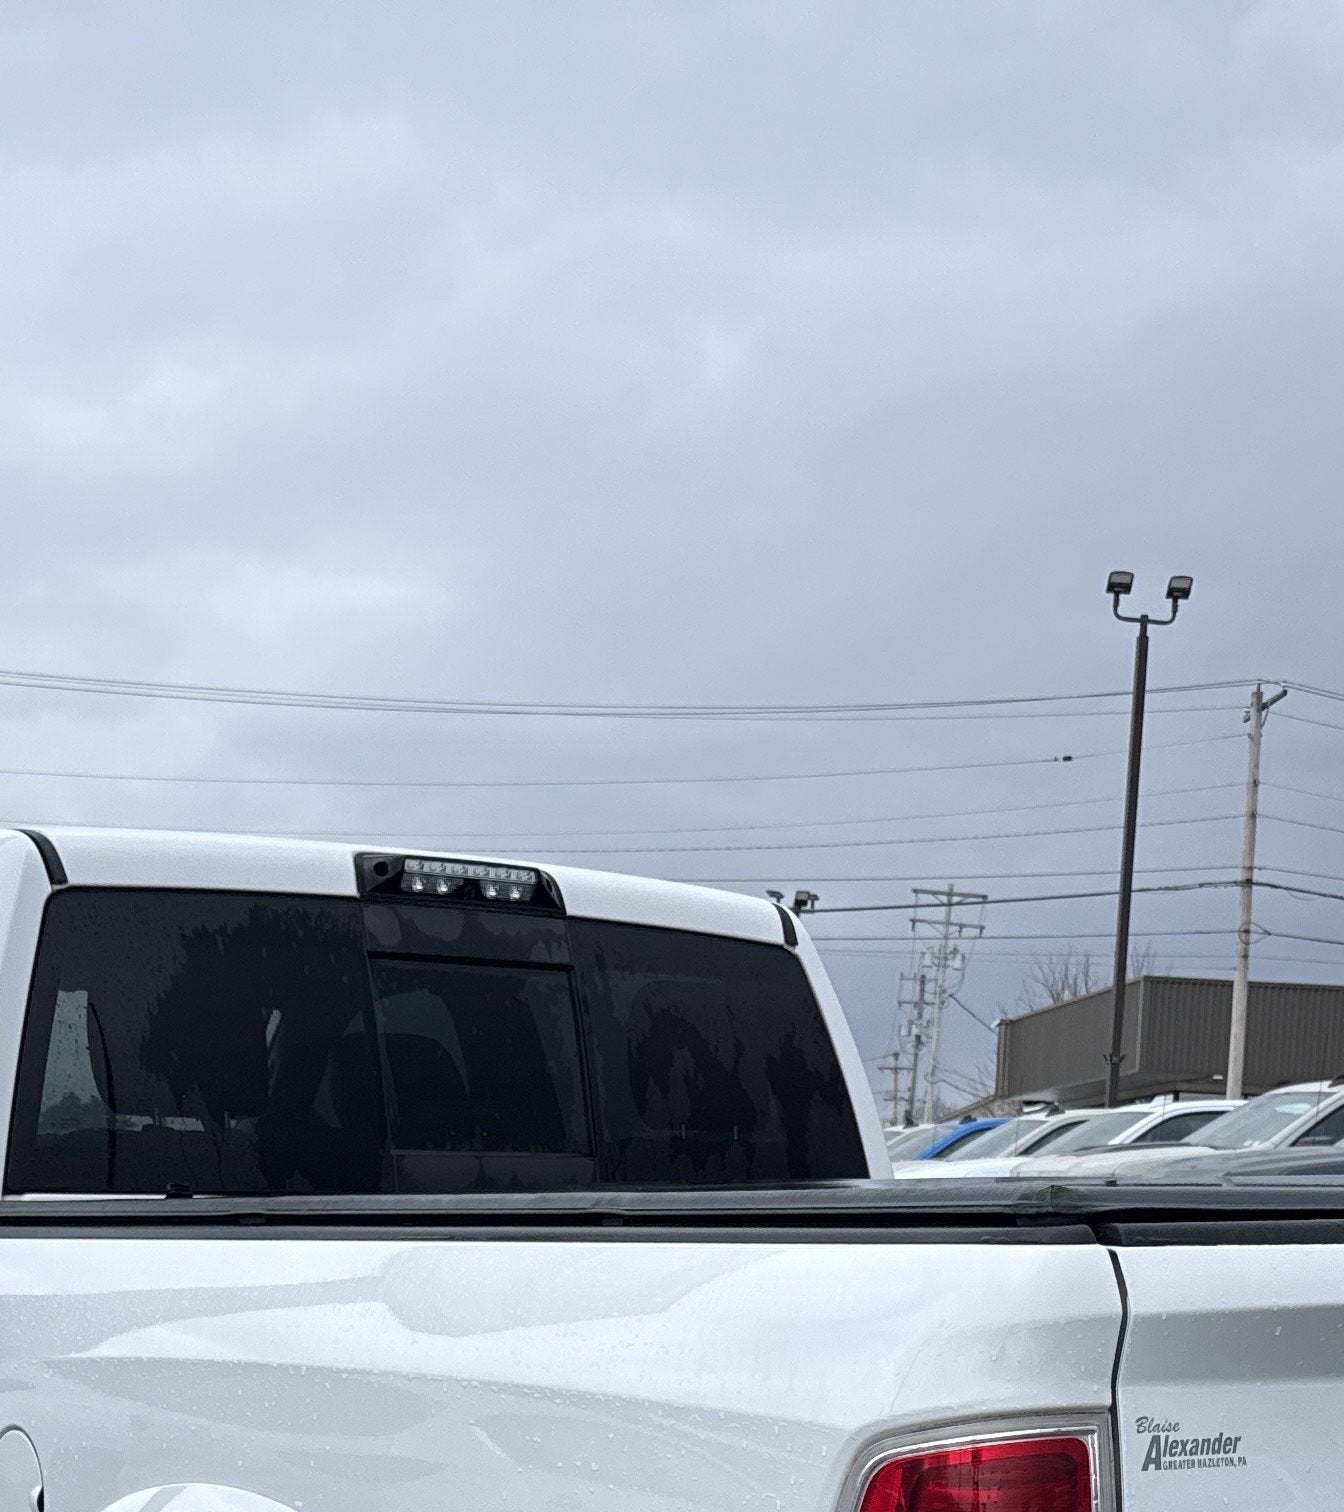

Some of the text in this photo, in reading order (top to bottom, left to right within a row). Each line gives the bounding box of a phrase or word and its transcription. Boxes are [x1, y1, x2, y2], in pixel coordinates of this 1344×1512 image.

[1135, 1416, 1181, 1434] Blaise
[1140, 1432, 1242, 1472] Alexander
[1162, 1458, 1196, 1471] GREATER
[1237, 1456, 1247, 1467] PA
